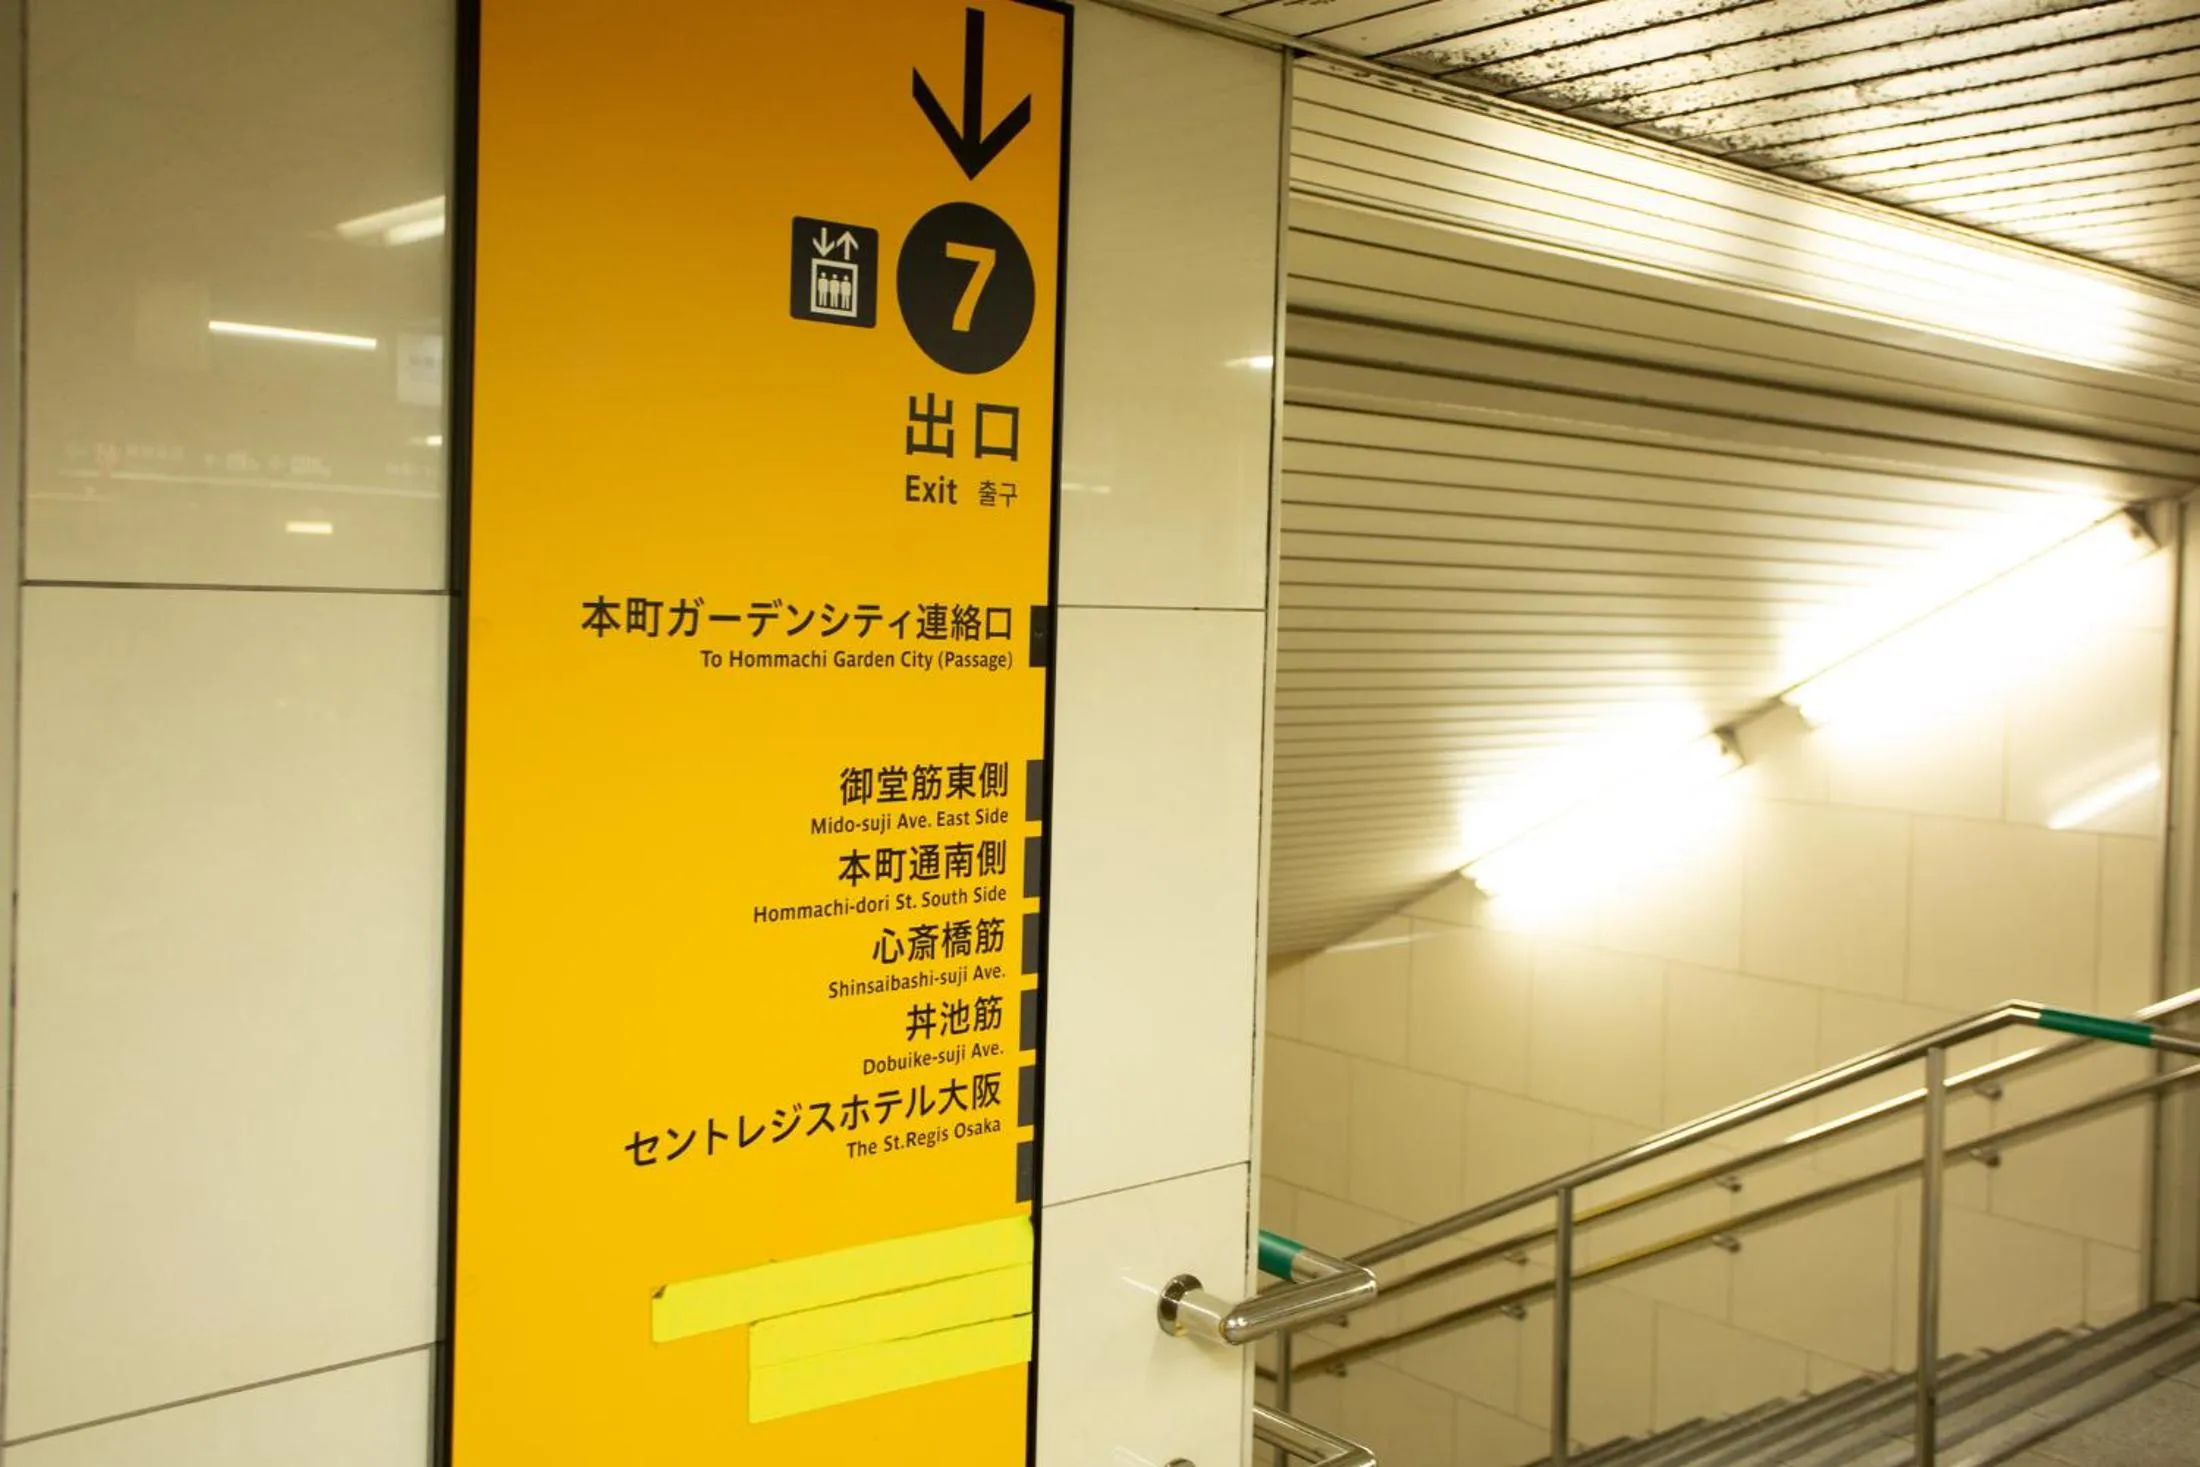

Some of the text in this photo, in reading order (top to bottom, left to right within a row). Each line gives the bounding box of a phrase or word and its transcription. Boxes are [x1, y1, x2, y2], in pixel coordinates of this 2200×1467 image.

[945, 241, 996, 332] 7
[905, 474, 957, 505] Exit
[978, 480, 1017, 507] 출구
[581, 594, 1012, 642] 本町ガーデンシティ連絡口
[700, 650, 1013, 672] To Hommachi Garden City (Passage)
[839, 761, 1009, 806] 御堂筋東側
[811, 808, 1009, 835] Mido-suji Ave. East Side
[838, 839, 1007, 888] 本町通南側
[753, 885, 1007, 923] Hommachi-dori St. South Side
[872, 916, 1005, 965] 心斎橋筋
[828, 965, 1006, 999] Shinsaibashi-suji Ave.
[905, 994, 1003, 1042] 丼池筋
[863, 1042, 1005, 1076] Dobuike-suji Ave.
[624, 1071, 1002, 1167] セントレジスホテル大阪
[846, 1141, 877, 1158] The
[954, 1119, 1001, 1139] Osaka
